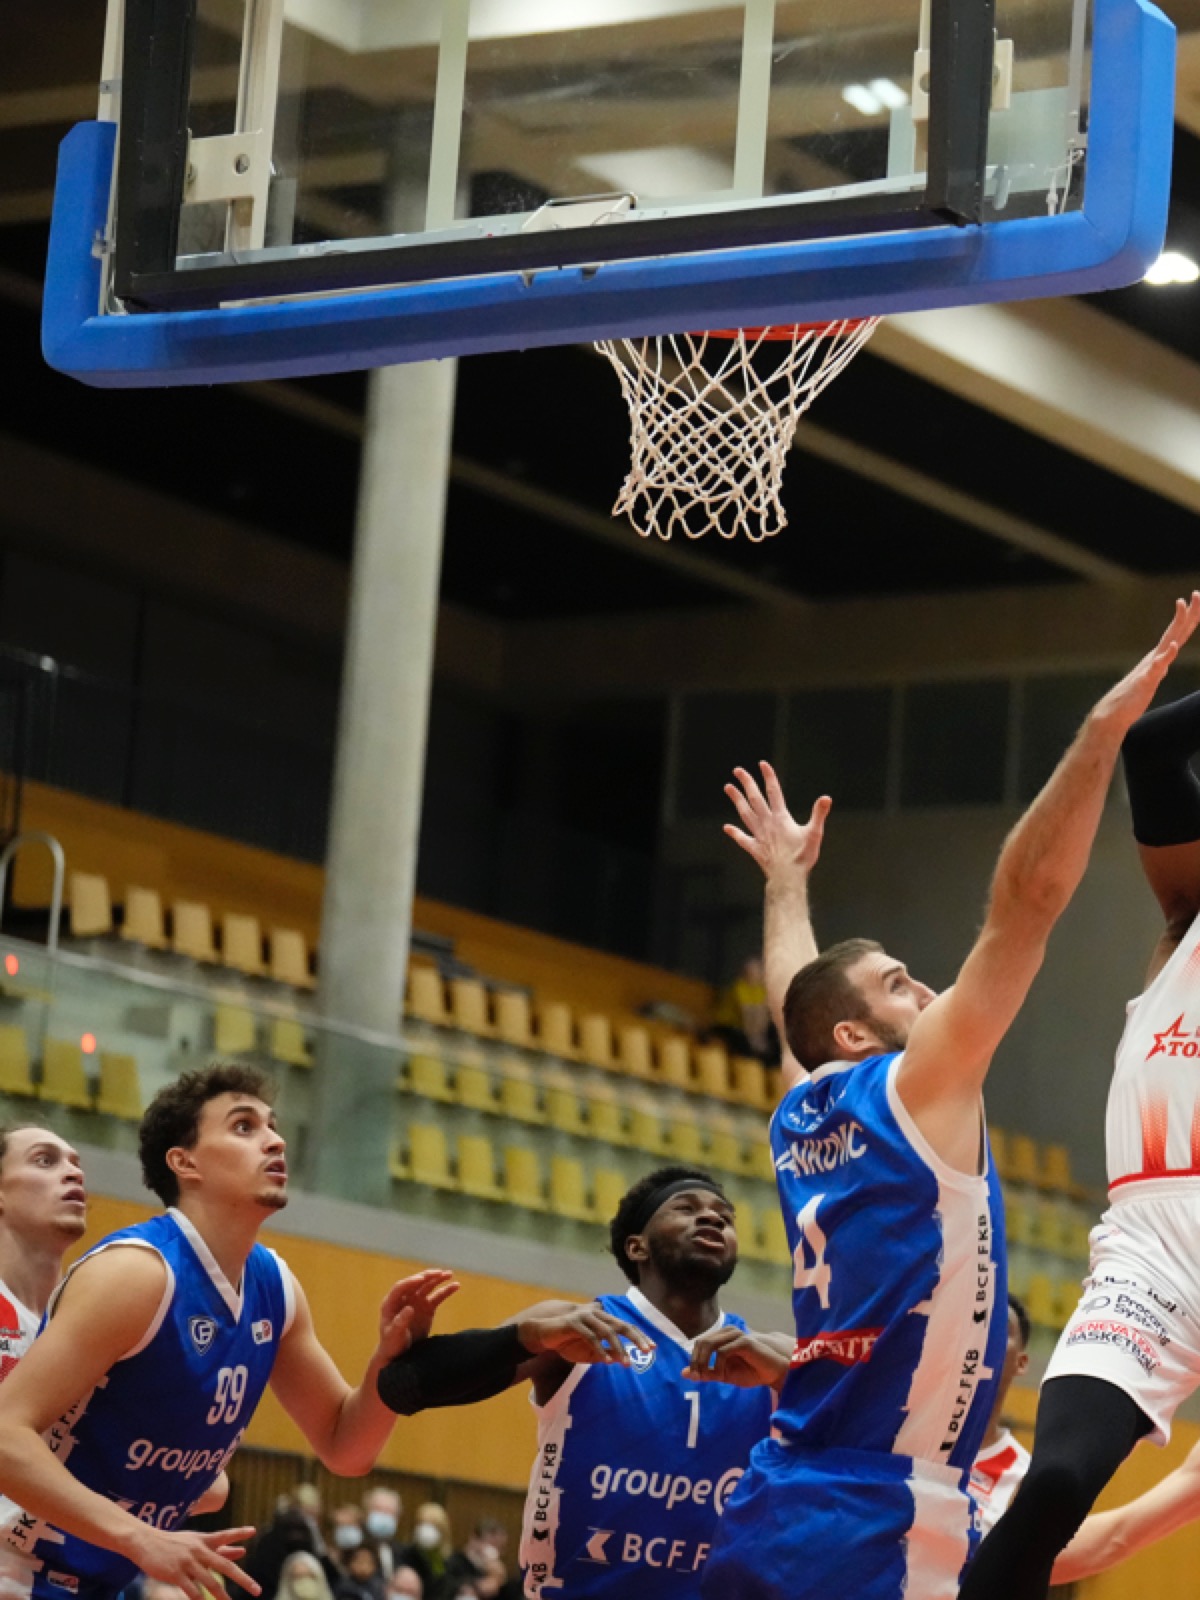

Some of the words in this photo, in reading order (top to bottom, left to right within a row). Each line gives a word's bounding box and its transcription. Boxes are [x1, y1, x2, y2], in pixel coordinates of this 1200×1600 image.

[793, 1193, 832, 1310] 4
[206, 1365, 249, 1425] 99
[683, 1391, 700, 1448] 1
